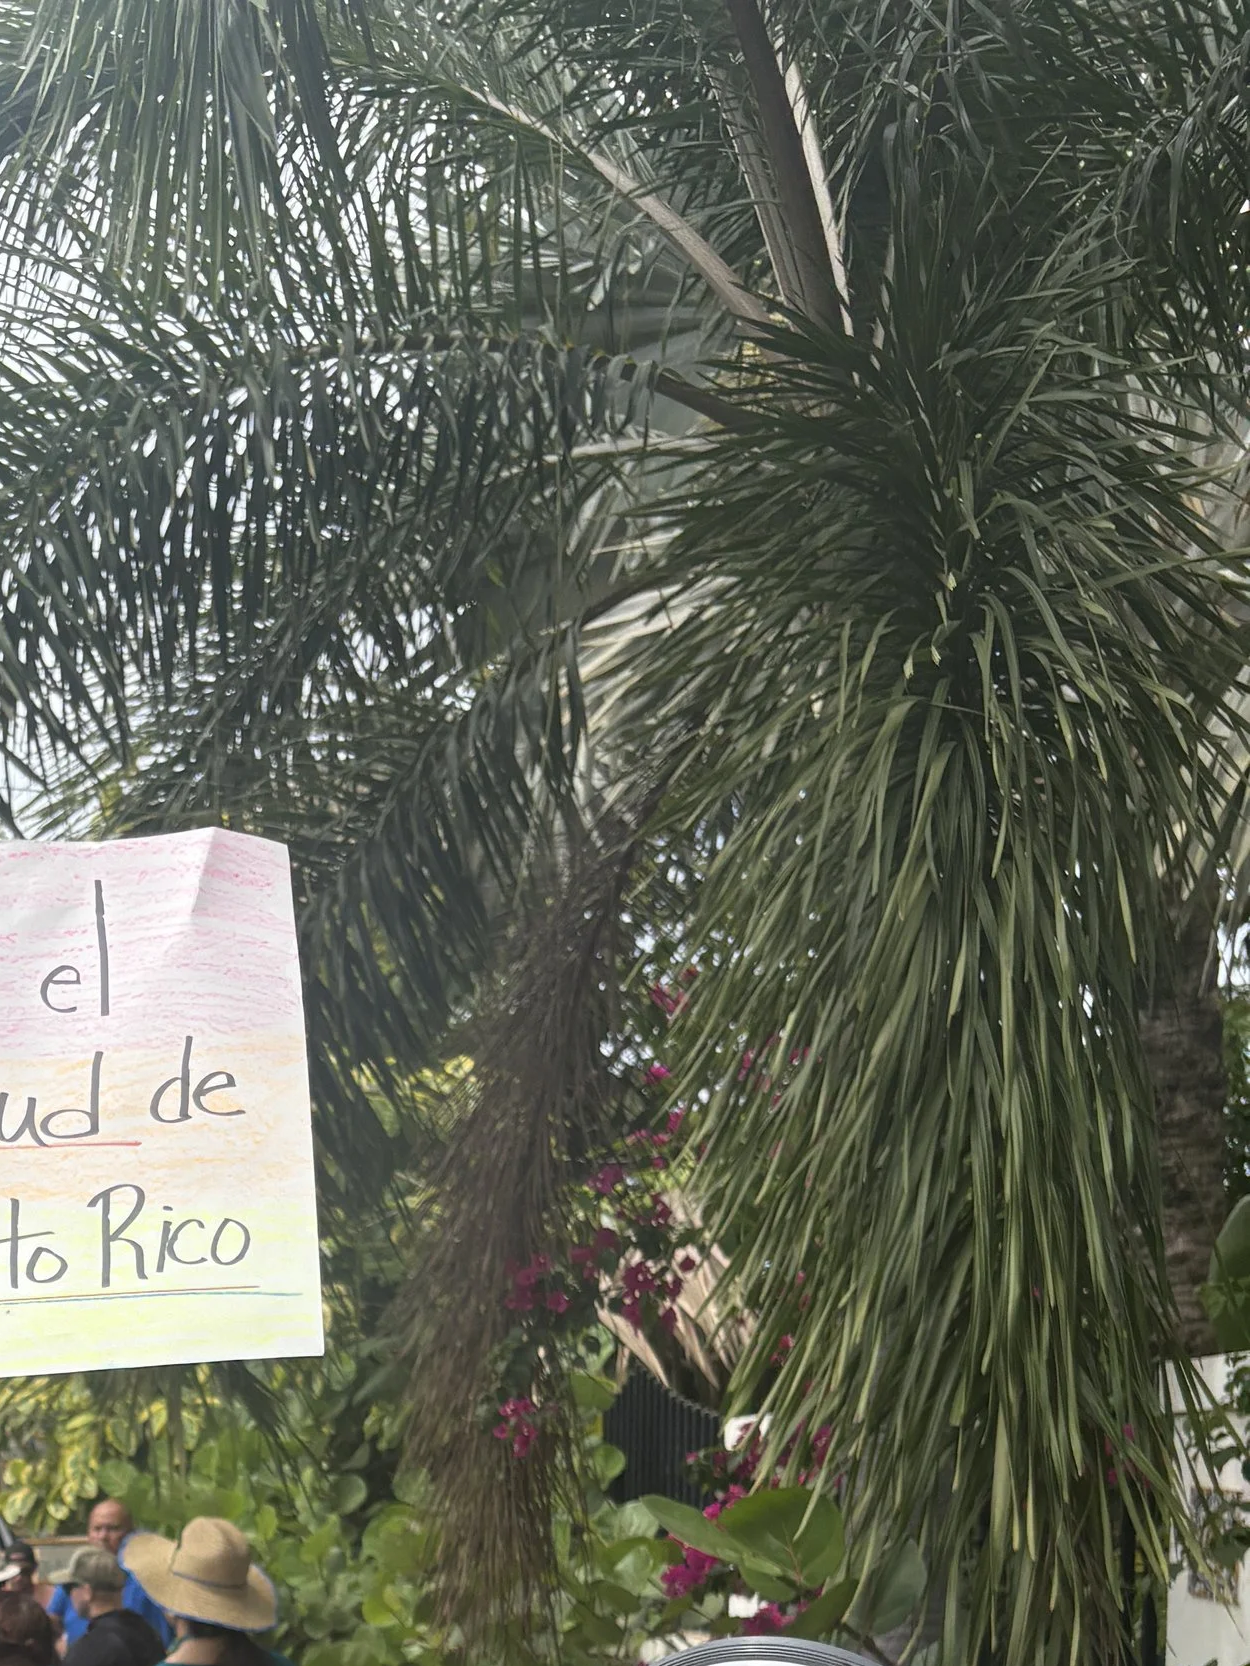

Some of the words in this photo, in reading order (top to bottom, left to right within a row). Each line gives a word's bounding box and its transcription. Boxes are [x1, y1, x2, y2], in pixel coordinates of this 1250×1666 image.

[40, 879, 111, 1016] el
[150, 1034, 247, 1127] de
[89, 1183, 251, 1288] Rico
